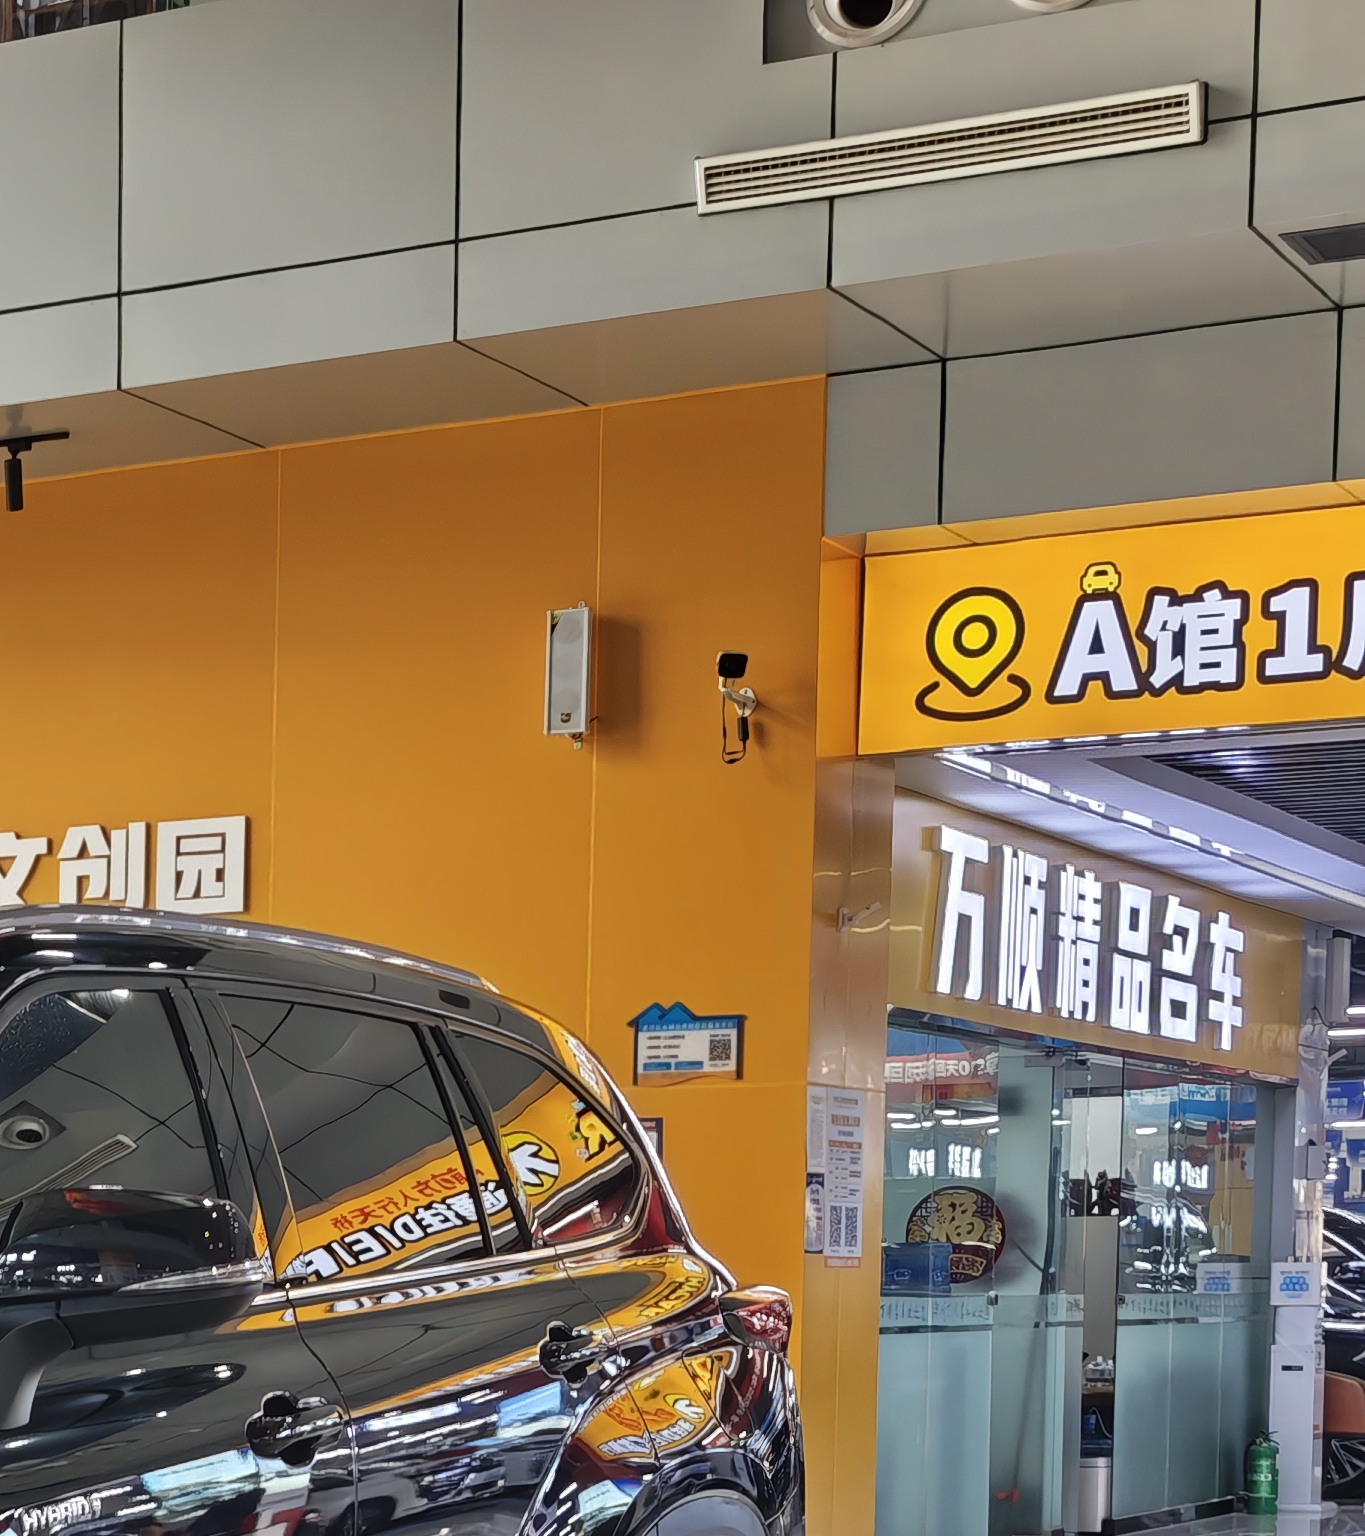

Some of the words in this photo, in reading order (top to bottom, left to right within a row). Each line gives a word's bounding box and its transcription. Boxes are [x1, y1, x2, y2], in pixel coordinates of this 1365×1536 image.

[935, 825, 1245, 1051] 万顺精品名车
[22, 1495, 91, 1534] HYBRID
